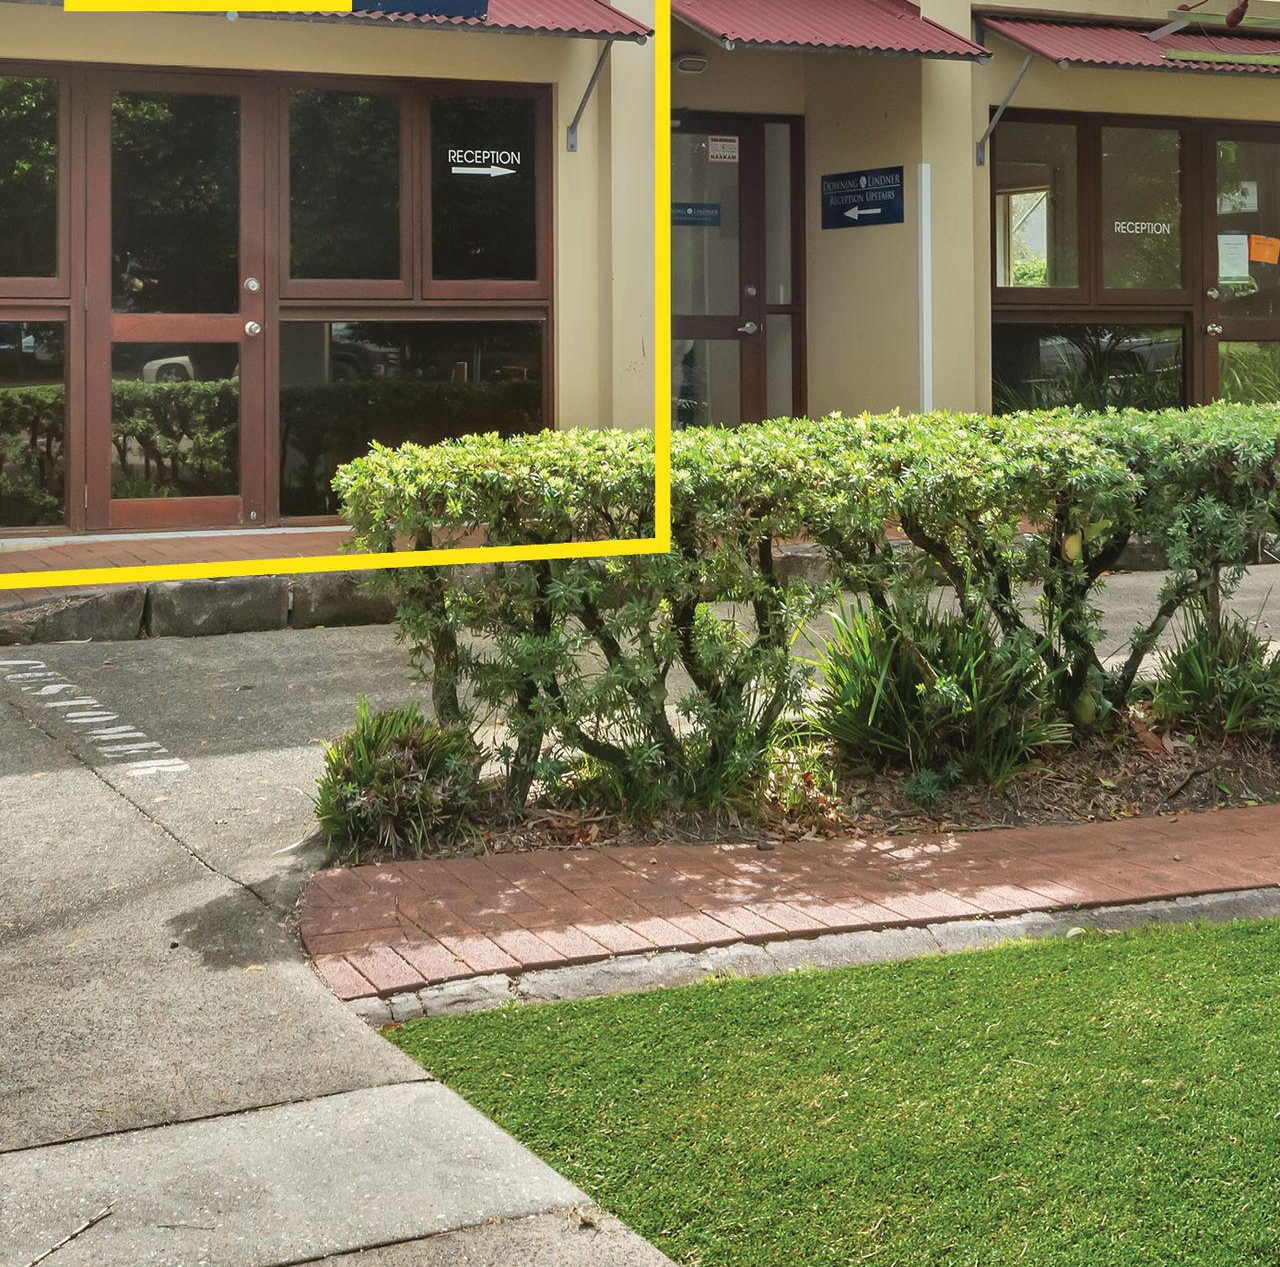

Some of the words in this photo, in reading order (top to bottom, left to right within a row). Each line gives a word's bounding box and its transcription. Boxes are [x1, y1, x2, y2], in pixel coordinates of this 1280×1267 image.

[448, 149, 521, 164] RECEPTION
[823, 179, 859, 192] DOWNING
[868, 174, 900, 187] LINDNER
[829, 195, 864, 206] RECEPTION
[865, 190, 895, 202] UPSTAIRS
[1114, 221, 1170, 234] RECEPTION
